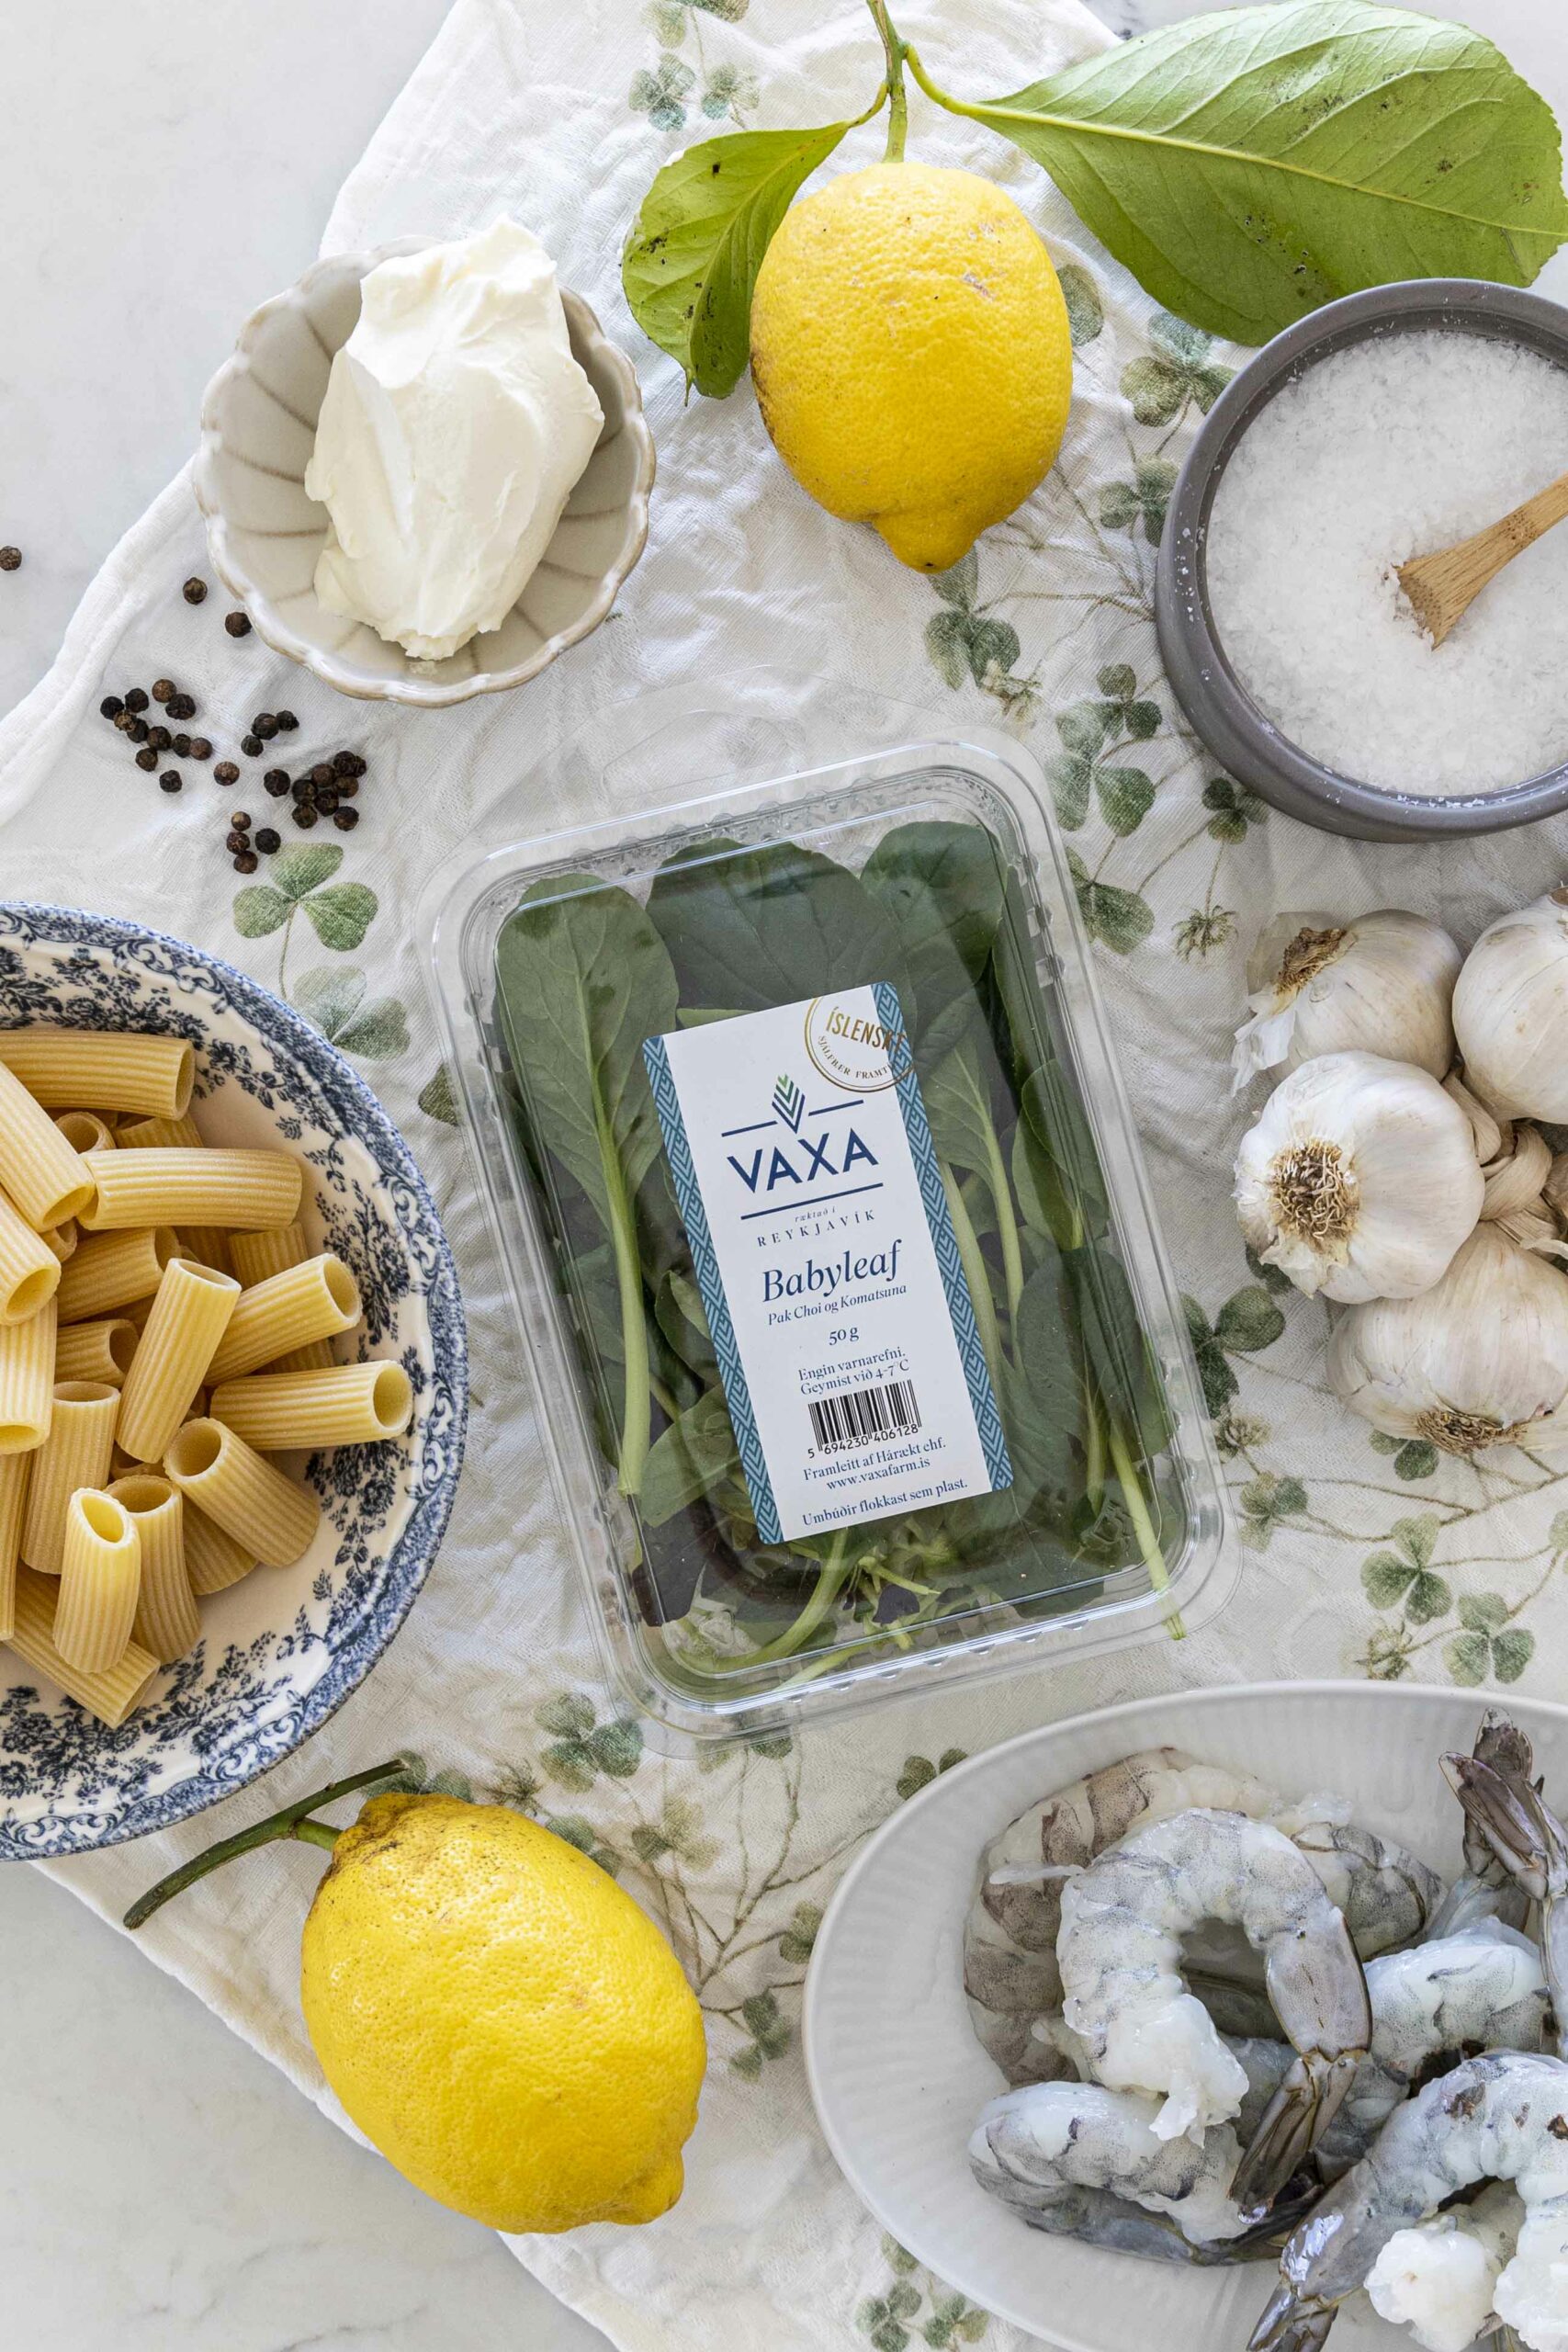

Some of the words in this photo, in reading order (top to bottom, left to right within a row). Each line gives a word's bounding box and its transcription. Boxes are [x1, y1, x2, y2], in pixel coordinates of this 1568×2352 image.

[727, 1127, 879, 1193] VAXA
[757, 1209, 875, 1247] REYKJAVÍK
[795, 1208, 829, 1223] ræktað
[762, 1238, 902, 1302] Babyleaf
[768, 1309, 792, 1325] Pak
[794, 1302, 821, 1318] Choi
[824, 1301, 839, 1314] og
[840, 1284, 907, 1308] Komatsuna
[829, 1329, 847, 1346] 50
[850, 1327, 860, 1341] g
[798, 1363, 835, 1381] Engin
[838, 1346, 906, 1371] varnarefni.
[800, 1375, 852, 1395] Geymist
[853, 1368, 873, 1382] við
[803, 1457, 861, 1480] Framleitt
[863, 1453, 874, 1467] af
[875, 1442, 921, 1464] Hárækt
[923, 1437, 946, 1453] ehf.
[807, 1448, 815, 1459] 5
[823, 1436, 869, 1454] 694230
[874, 1423, 919, 1442] 406128
[826, 1456, 931, 1490] www.vaxafarm.is
[803, 1505, 858, 1526] Umbúðir
[859, 1492, 908, 1513] flokkast
[909, 1487, 933, 1500] sem
[935, 1477, 968, 1498] plast.
